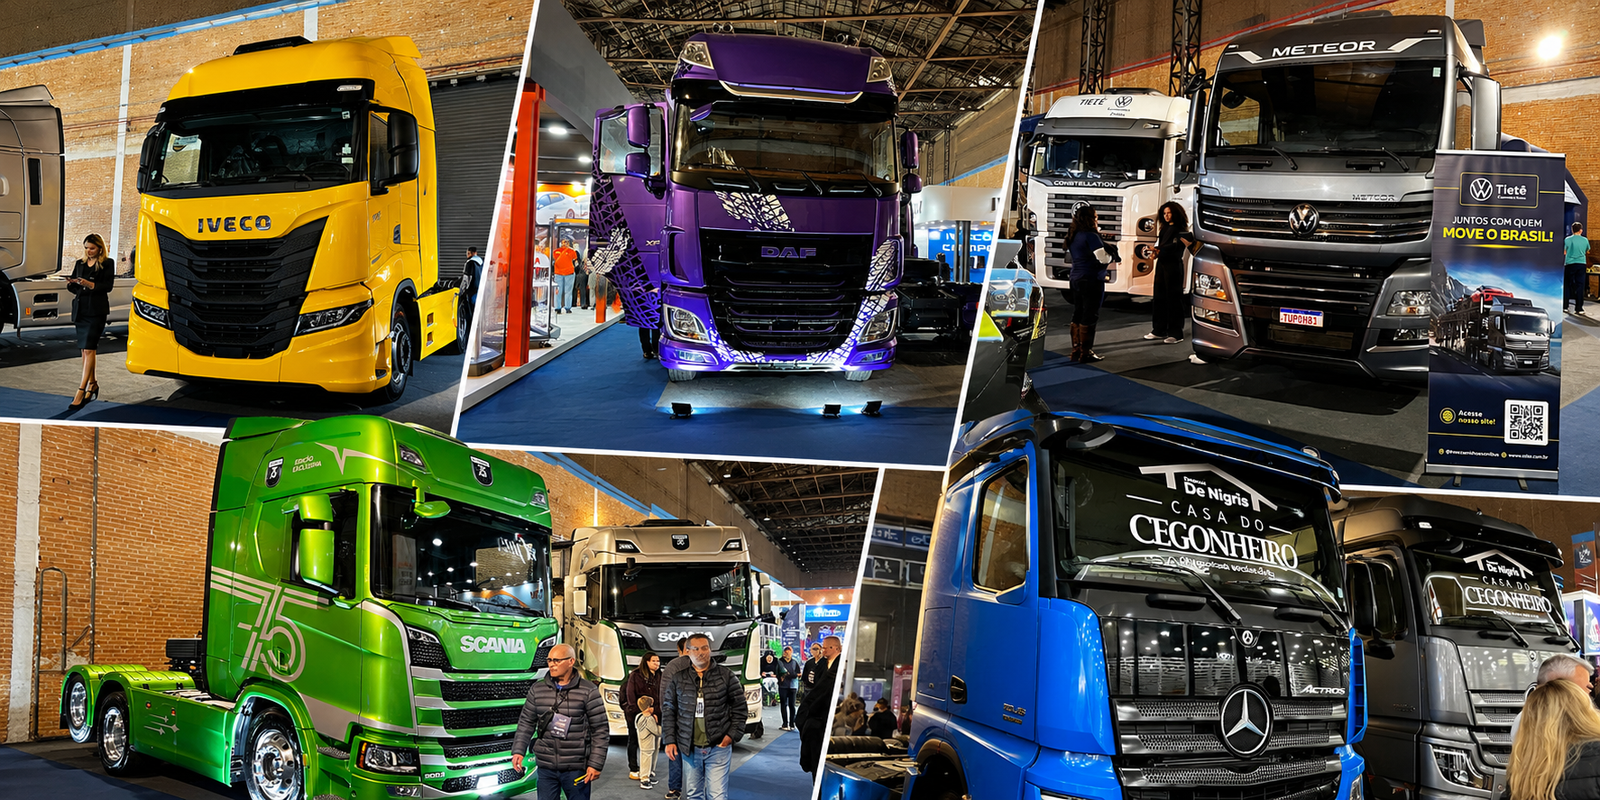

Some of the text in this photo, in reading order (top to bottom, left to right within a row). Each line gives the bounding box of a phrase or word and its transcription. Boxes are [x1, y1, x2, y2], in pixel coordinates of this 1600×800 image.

[1272, 40, 1376, 57] METEOR
[1053, 180, 1117, 188] CONSTELLATION
[197, 215, 271, 233] IVECO
[1452, 216, 1543, 228] JUNTOS COM QUEM
[1442, 227, 1554, 243] MOVE O BRASIL!
[761, 246, 817, 259] DAF
[1458, 409, 1483, 418] Acesse
[1479, 418, 1496, 426] site!
[1184, 482, 1250, 508] De Nigris
[1171, 500, 1264, 532] CASA DO
[1129, 513, 1299, 570] CEGONHEIRO
[1482, 575, 1531, 592] CASA DO
[1464, 585, 1553, 614] CEGONHEIRO
[459, 635, 527, 654] SCANIA
[657, 631, 715, 643] SCAA
